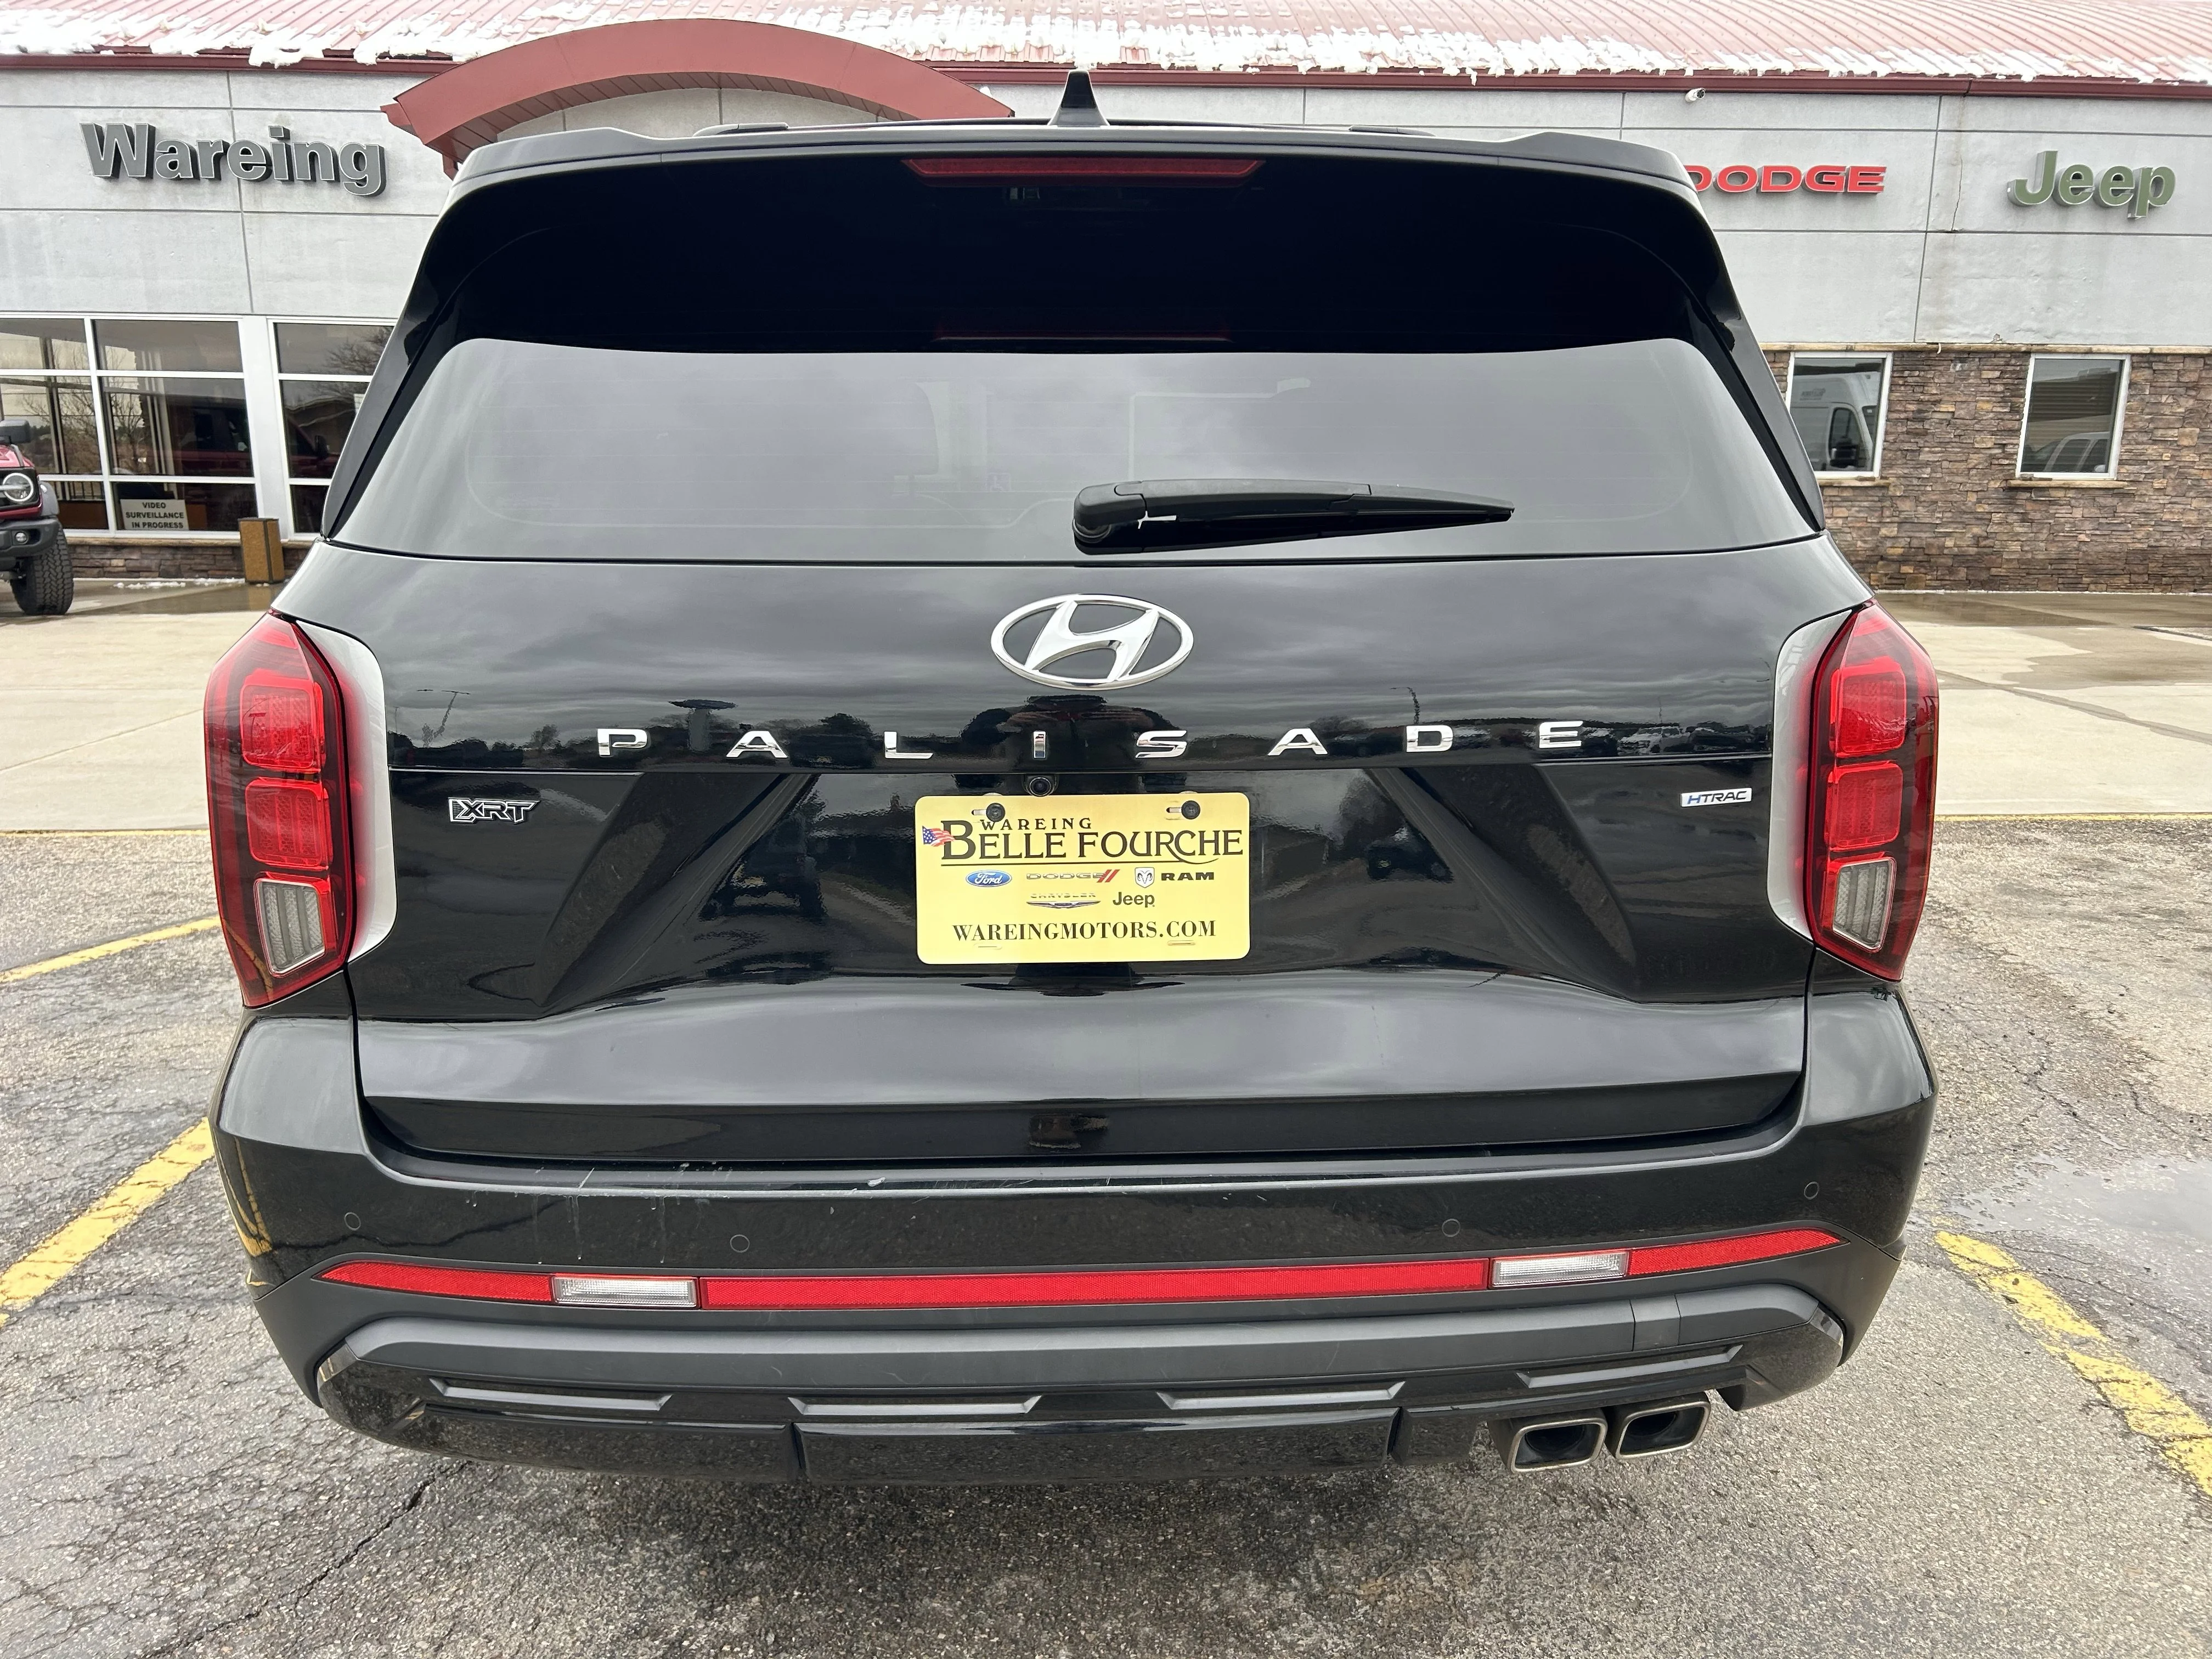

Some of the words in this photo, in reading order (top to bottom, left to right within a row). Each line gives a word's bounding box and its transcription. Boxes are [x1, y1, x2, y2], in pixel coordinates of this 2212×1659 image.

[80, 122, 386, 196] Wareing
[2008, 150, 2176, 219] Jeep
[597, 720, 1583, 759] PALISADE
[1686, 791, 1748, 805] HTRAC
[453, 798, 540, 823] XRT
[980, 817, 1092, 831] WAREING
[941, 820, 1066, 860] BELLE
[1078, 830, 1243, 865] FOURCHE
[1026, 872, 1107, 881] DODGE
[1161, 872, 1215, 881] RAM
[1113, 891, 1155, 908] Jeep
[952, 920, 1216, 941] WAREINGMOTORS.COM
